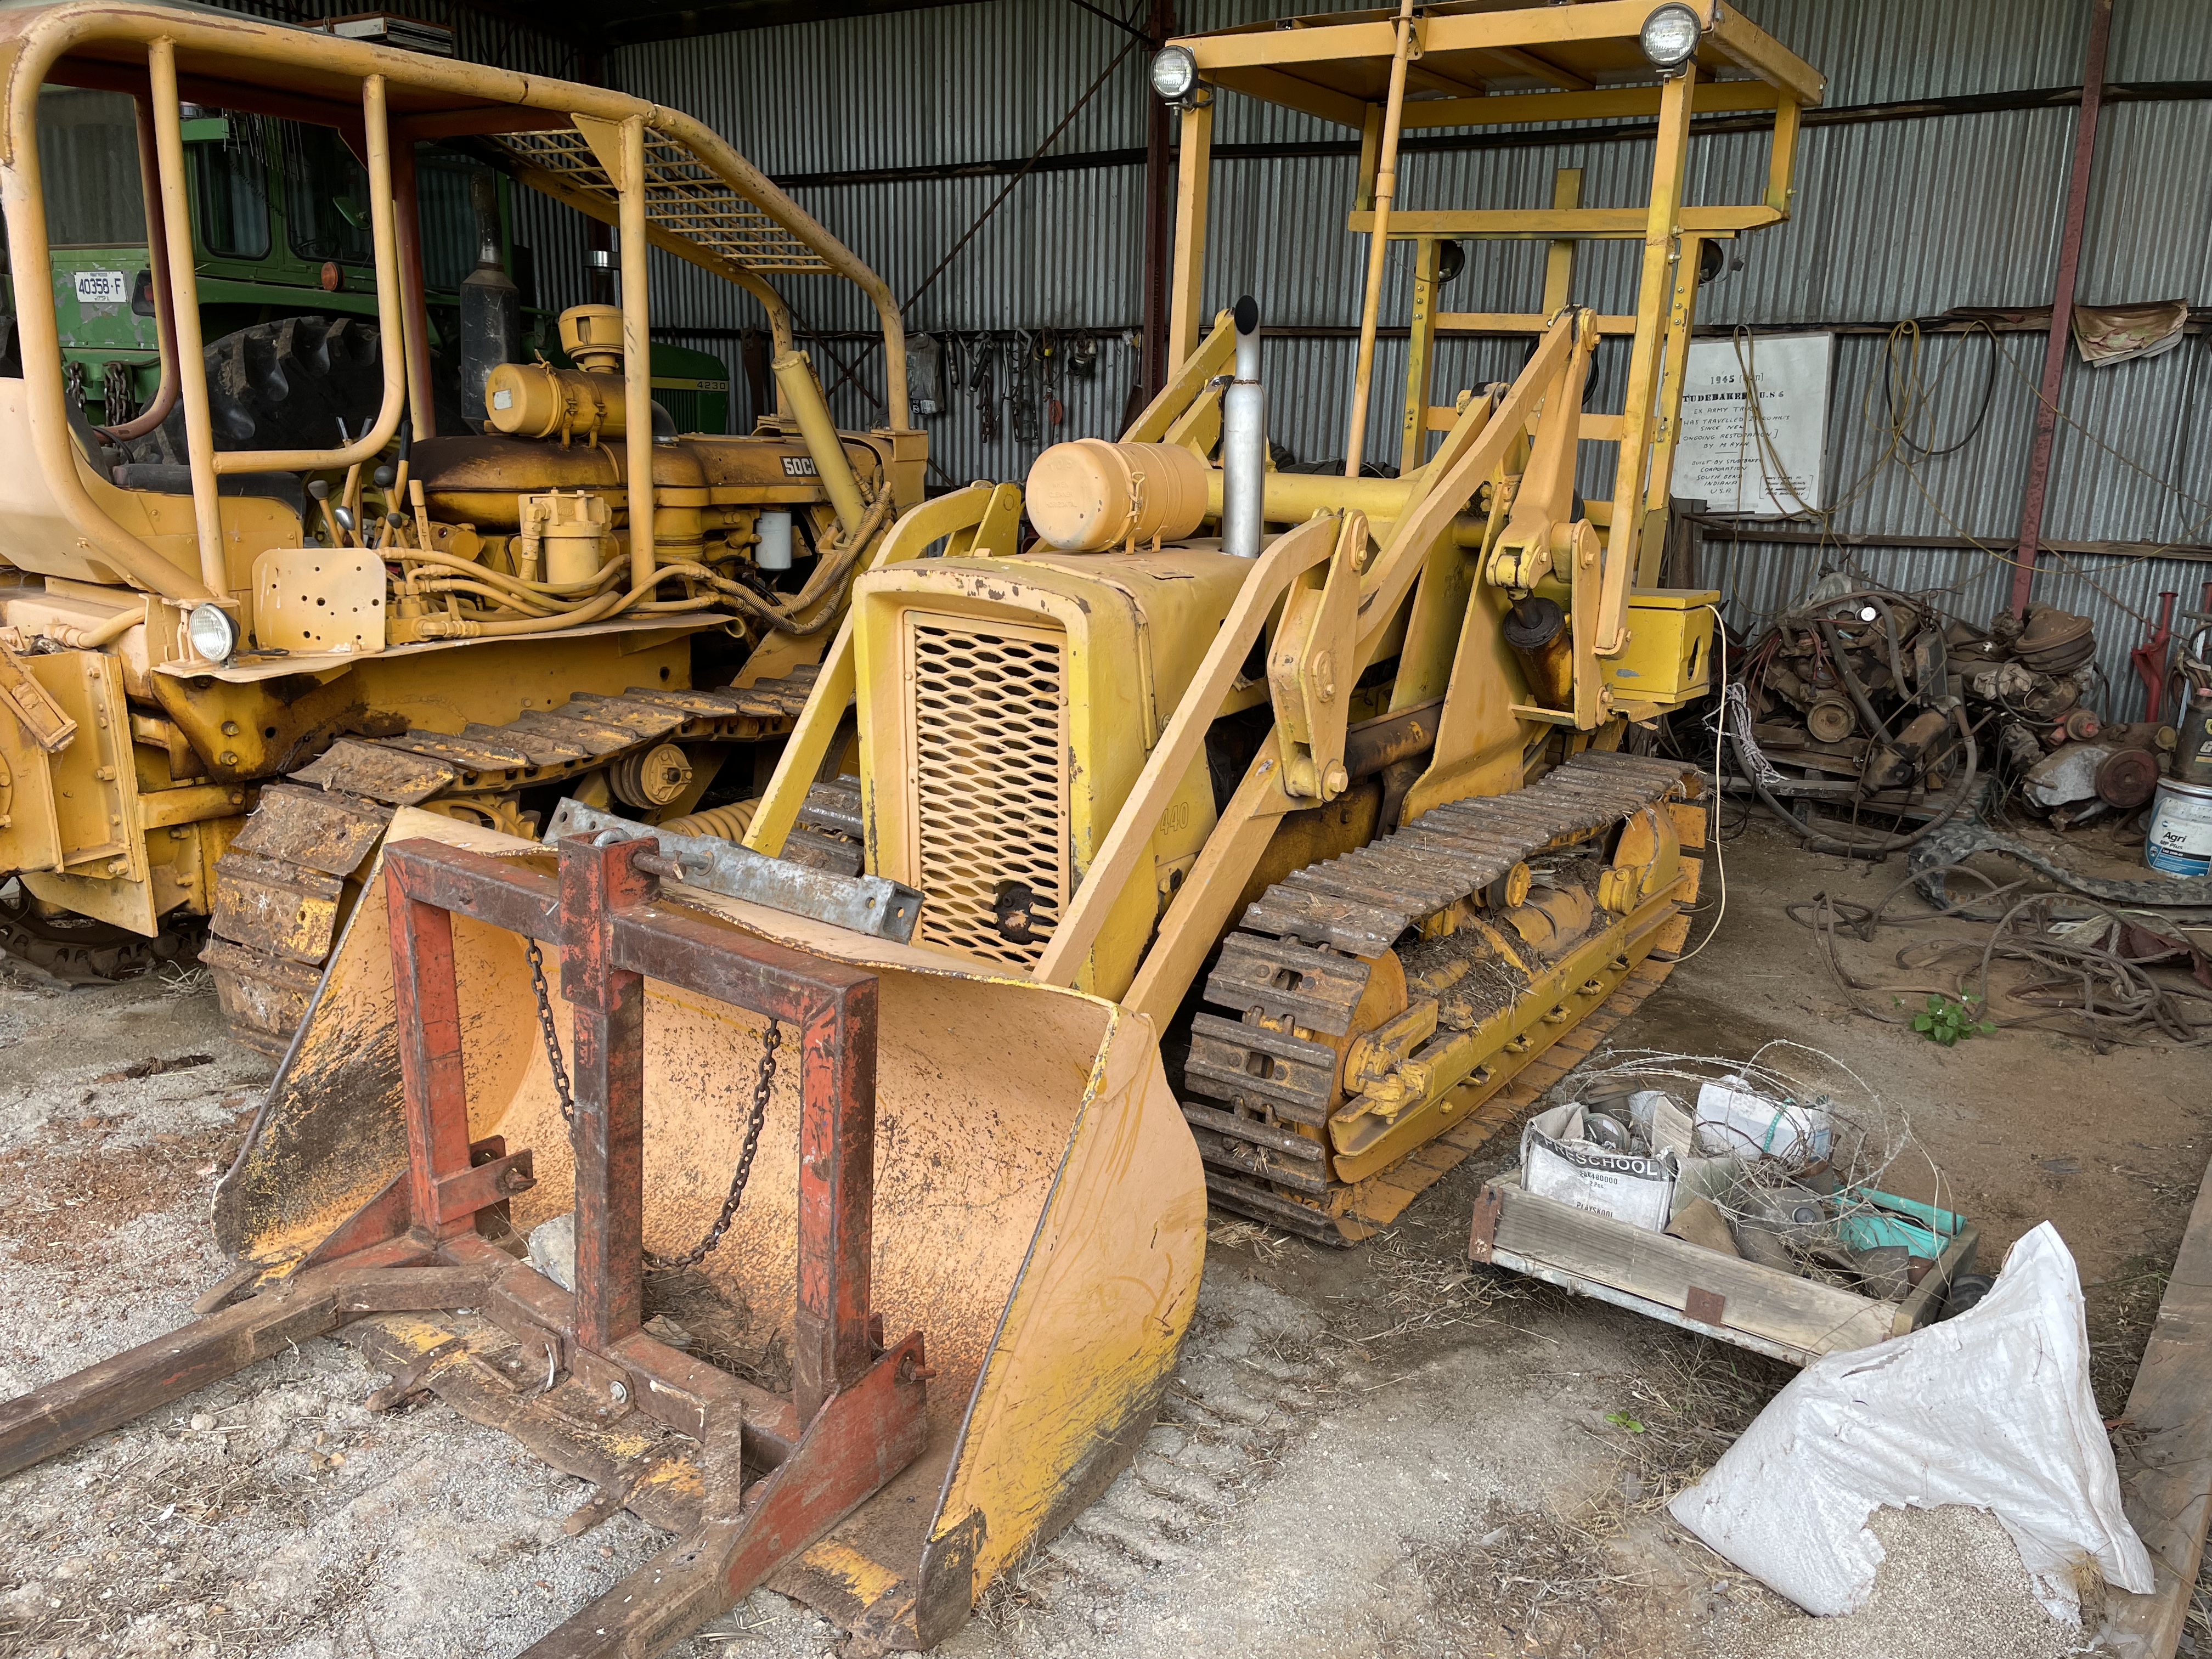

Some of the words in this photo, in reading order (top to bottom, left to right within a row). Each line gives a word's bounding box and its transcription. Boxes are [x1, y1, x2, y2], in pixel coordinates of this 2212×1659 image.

[697, 381, 725, 390] 4230
[1711, 375, 1735, 385] 1945
[1683, 392, 1748, 403] TUDEBAKER
[1160, 802, 1189, 836] 440
[2163, 832, 2188, 843] Agri
[1543, 1136, 1658, 1176] PRESCHOOL
